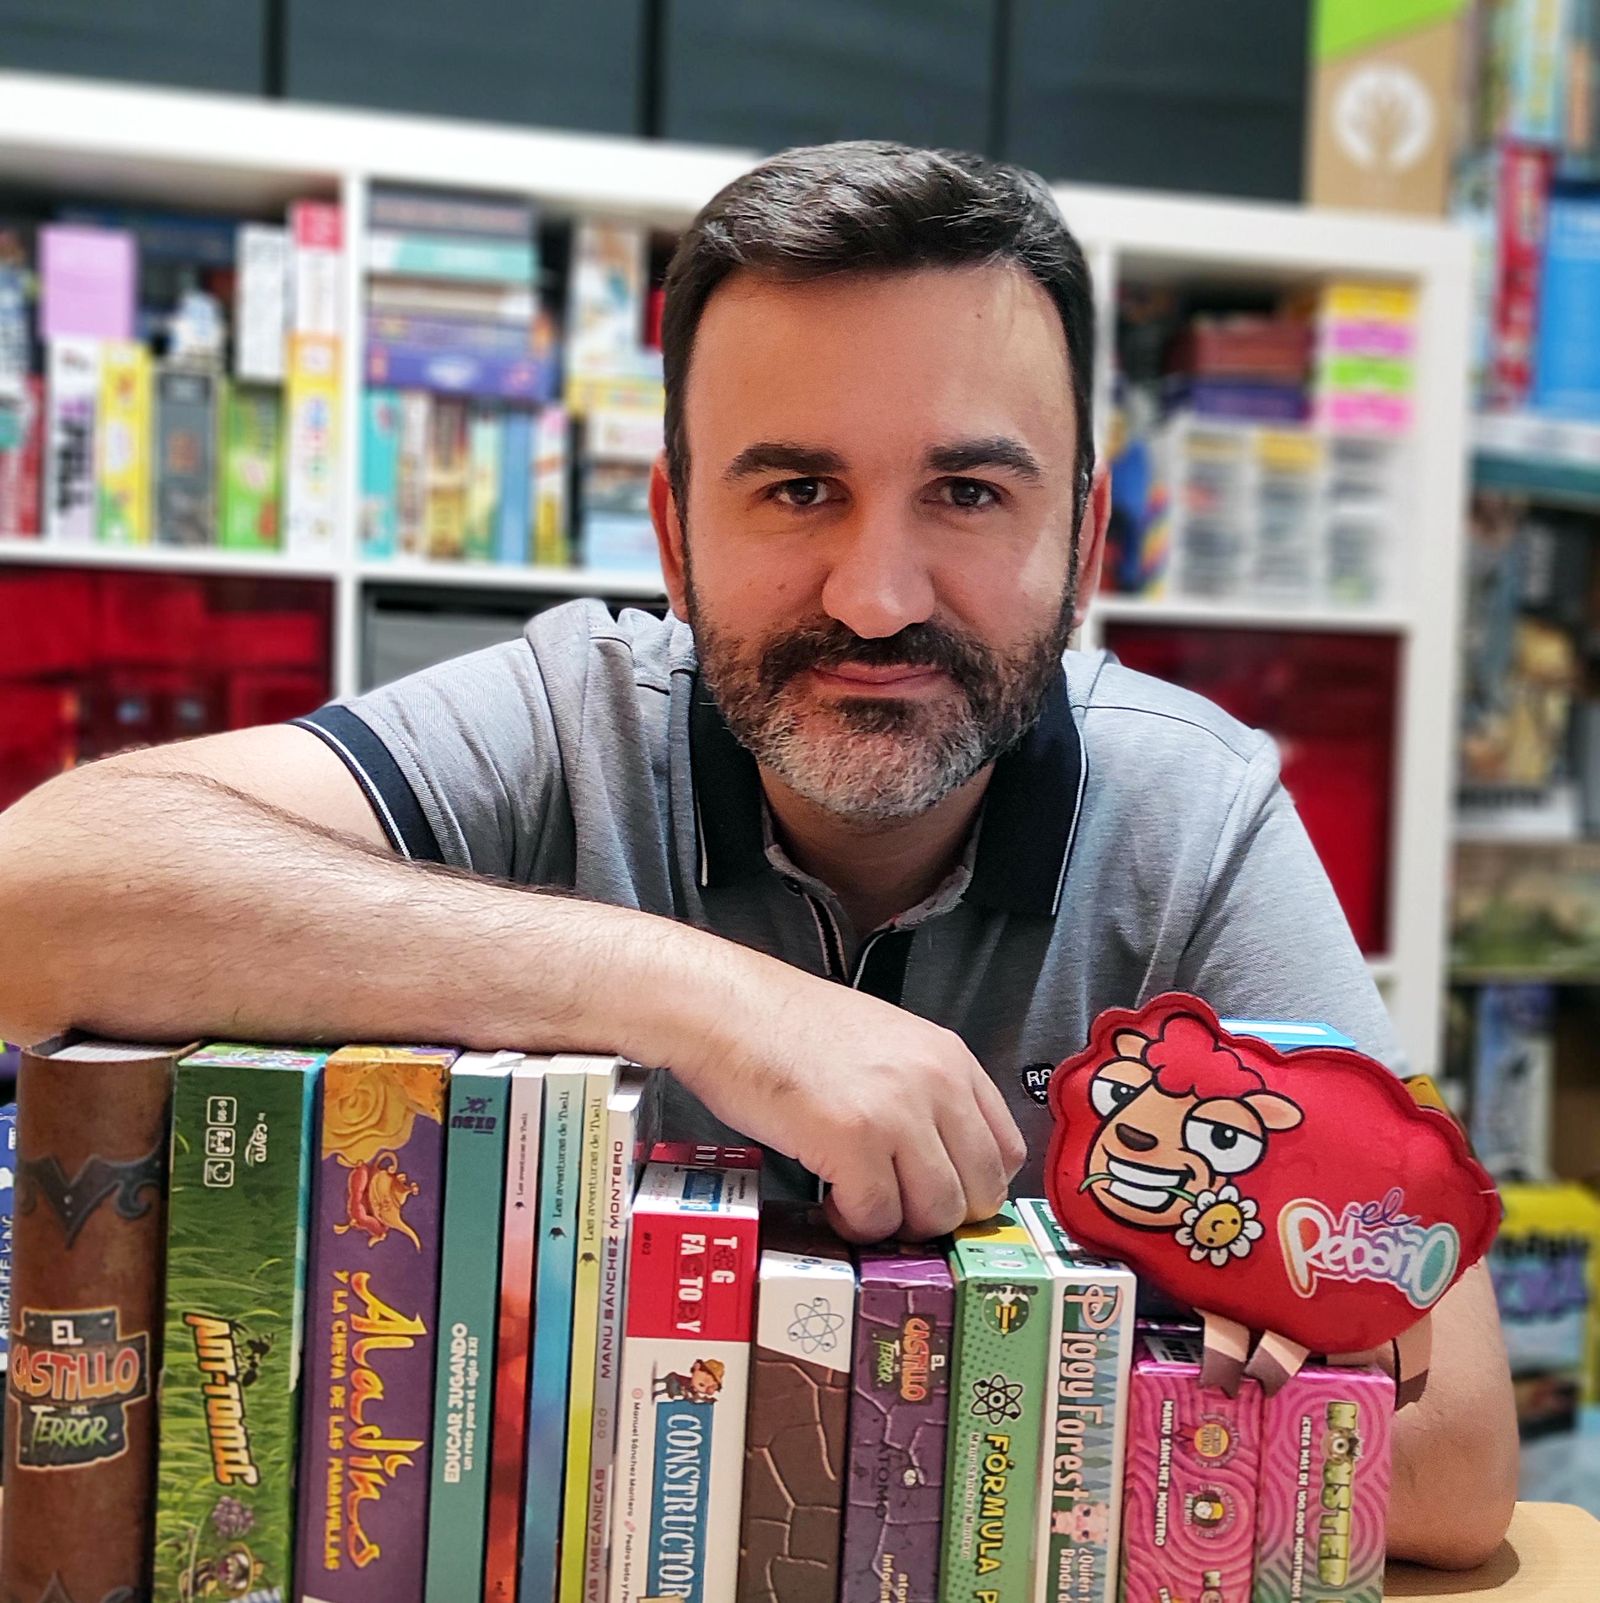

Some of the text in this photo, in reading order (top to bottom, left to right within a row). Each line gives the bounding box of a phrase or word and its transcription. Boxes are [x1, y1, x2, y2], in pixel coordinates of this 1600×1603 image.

[254, 1123, 268, 1163] cayro
[558, 1123, 568, 1137] de
[590, 1134, 601, 1149] de
[555, 1138, 567, 1193] aventuras
[587, 1152, 600, 1217] aventuras
[1346, 1187, 1420, 1227] el
[600, 1140, 625, 1378] MANU SÁNCHEZ MONTERO
[51, 1319, 84, 1346] EL
[1059, 1284, 1123, 1399] Piggy
[12, 1343, 141, 1401] CASTILLO
[466, 1359, 480, 1387] siglo
[900, 1317, 930, 1401] CASTILLO
[930, 1354, 946, 1371] EL
[443, 1322, 468, 1483] EDUCAR JUGANDO
[465, 1402, 477, 1429] para
[466, 1389, 476, 1400] el
[323, 1269, 349, 1571] Y LA CUEVA DE LAS MARAVILLAS
[464, 1430, 475, 1455] reto
[463, 1455, 473, 1470] un
[626, 1402, 642, 1517] Manuel Sánchez Montero
[1053, 1403, 1104, 1502] Forest
[1154, 1400, 1175, 1547] MANU SÁNCHEZ MONTERO
[1298, 1472, 1309, 1487] DE
[1317, 1401, 1359, 1587] MONSTER
[589, 1469, 606, 1573] MECÁNICAS
[976, 1433, 1015, 1576] FÓRMULA
[623, 1533, 634, 1560] Pedro
[1057, 1548, 1076, 1591] Banda
[1291, 1537, 1306, 1599] MONSTRUOS
[622, 1561, 632, 1582] Soto
[1077, 1547, 1096, 1593] ¿Quién
